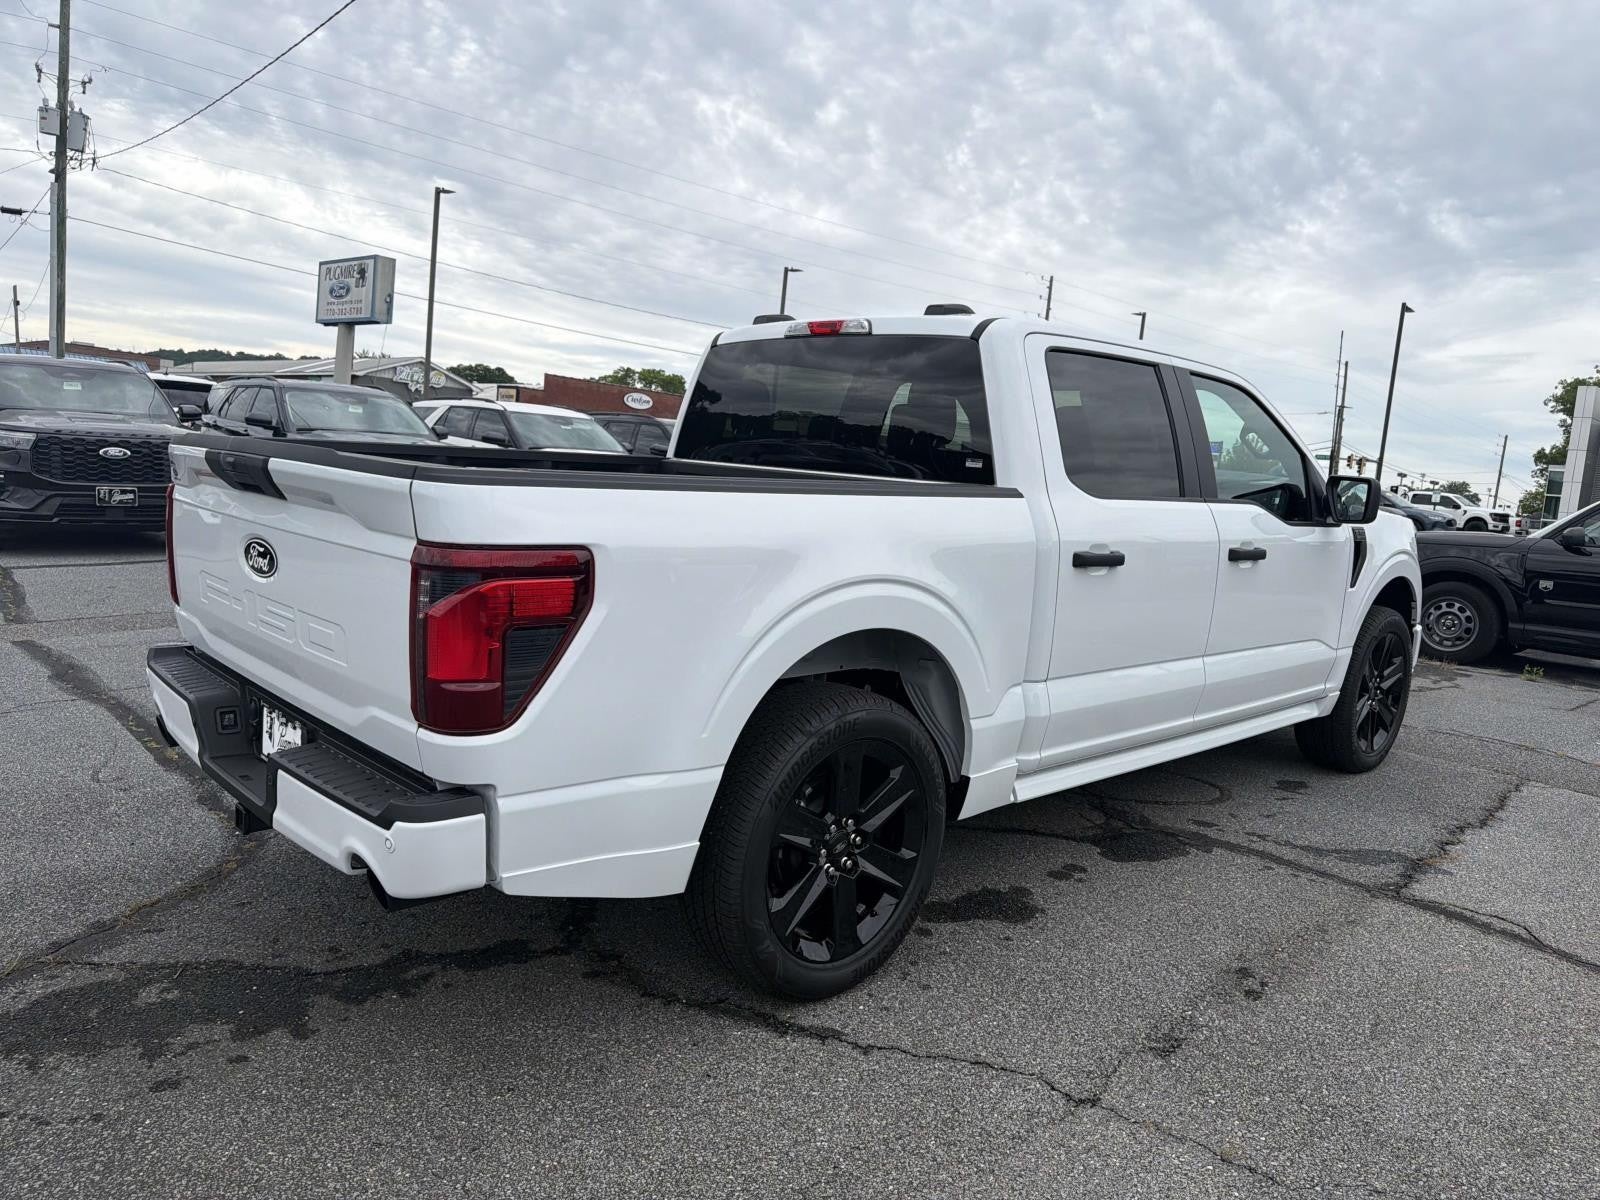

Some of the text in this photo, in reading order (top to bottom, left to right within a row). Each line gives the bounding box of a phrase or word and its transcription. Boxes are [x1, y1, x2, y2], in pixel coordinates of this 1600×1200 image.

[248, 543, 270, 572] Ford
[200, 570, 349, 666] F-150
[769, 717, 861, 809] BRIDGESTONE
